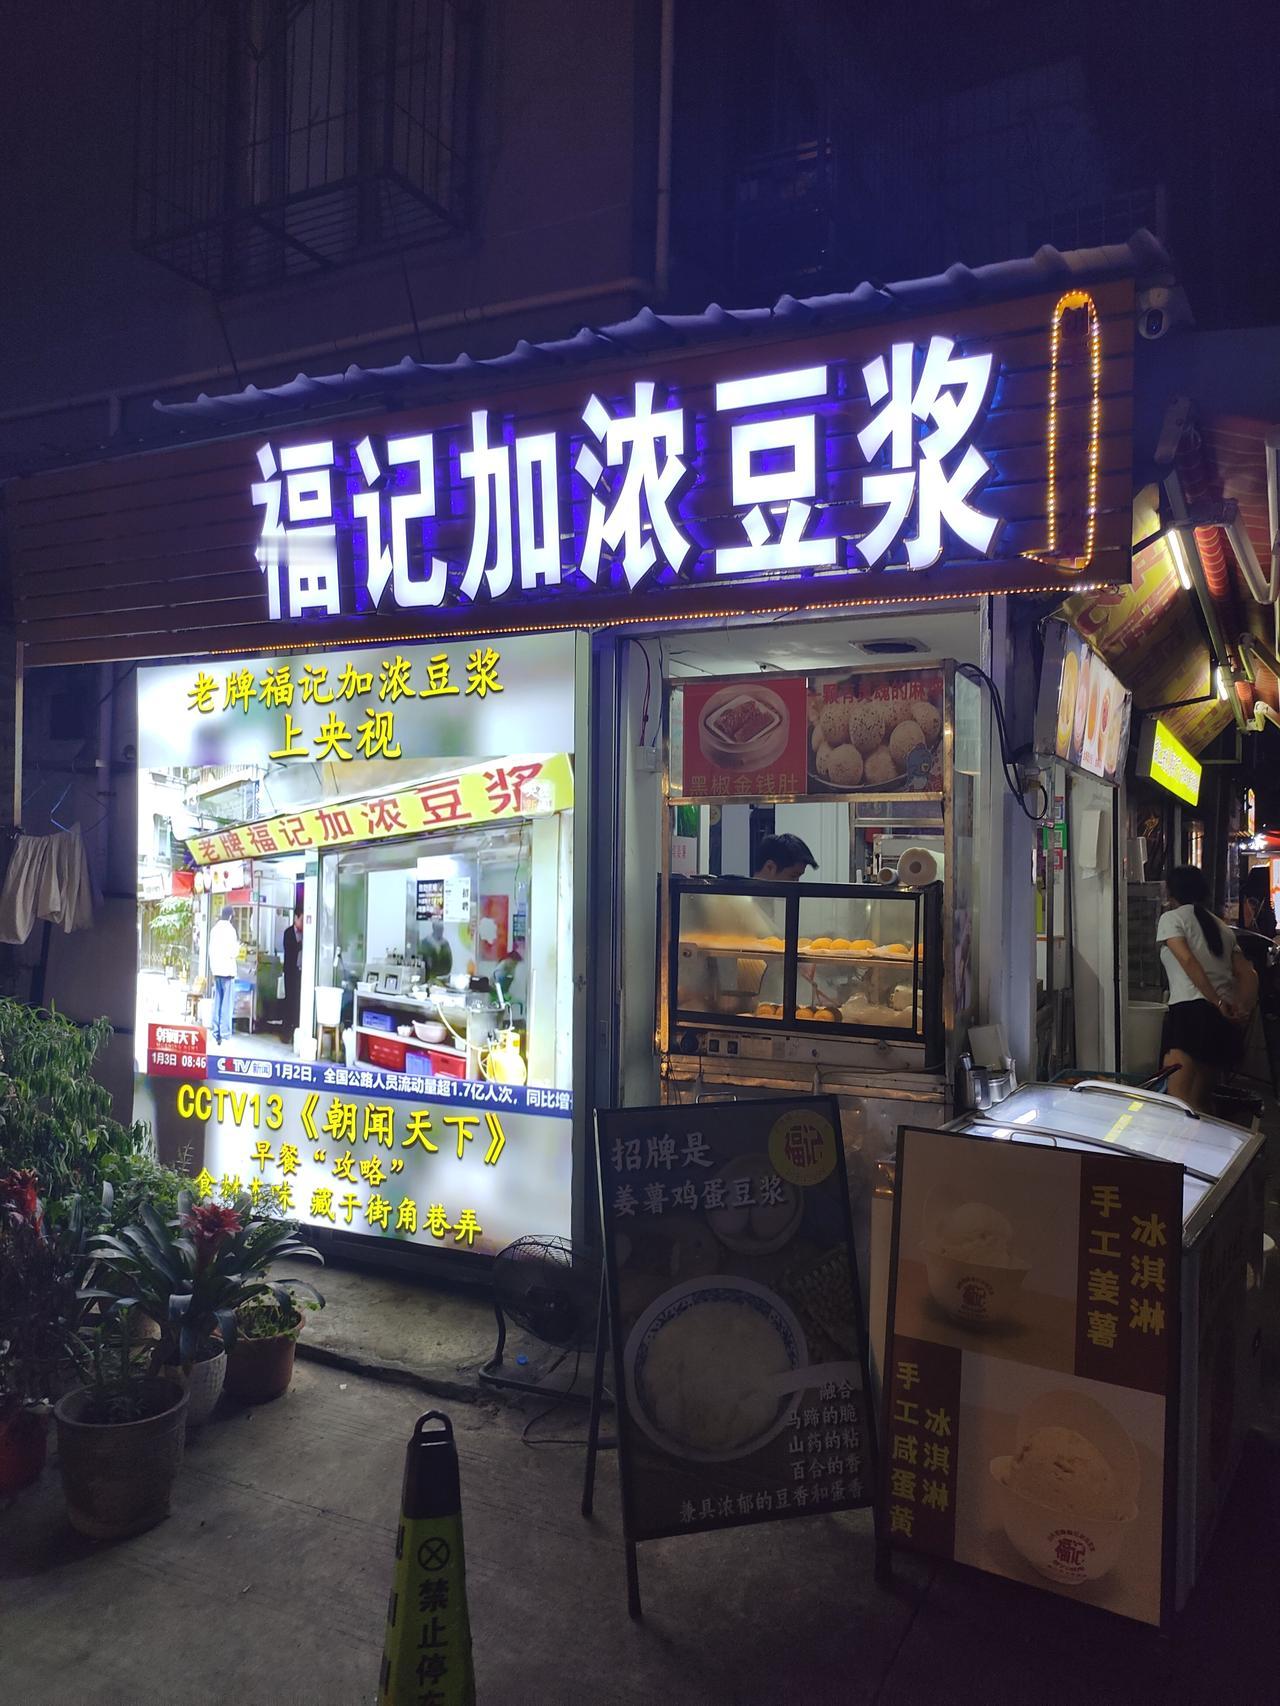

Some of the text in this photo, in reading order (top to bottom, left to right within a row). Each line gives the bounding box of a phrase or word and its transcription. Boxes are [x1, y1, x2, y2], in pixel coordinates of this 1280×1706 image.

[250, 335, 1000, 620] 福记加浓豆浆
[187, 647, 505, 715] 老牌福记加浓豆浆
[269, 709, 402, 761] 上央视
[688, 773, 800, 797] 黑椒金钱肚
[156, 1026, 200, 1046] 朝闻天下
[152, 1052, 207, 1069] 1月3日 08:46
[274, 1063, 572, 1110] 1月2日，全国公路人员流动量超1.7亿人次，同比增
[611, 1131, 715, 1173] 招牌是
[310, 1187, 483, 1246] 藏于街角巷弄
[612, 1174, 786, 1218] 姜薯鸡蛋豆浆
[1087, 1184, 1122, 1349] 手工姜薯
[1128, 1212, 1168, 1337] 冰淇淋
[819, 1378, 854, 1401] 融合
[786, 1403, 858, 1430] 马蹄的脆
[788, 1427, 861, 1454] 山药的粘
[889, 1360, 921, 1539] 手工咸蛋黄
[922, 1407, 952, 1513] 冰淇淋
[789, 1454, 865, 1481] 百合的香
[679, 1479, 865, 1523] 兼具浓郁的豆香和蛋香
[415, 1577, 449, 1706] 禁止停
